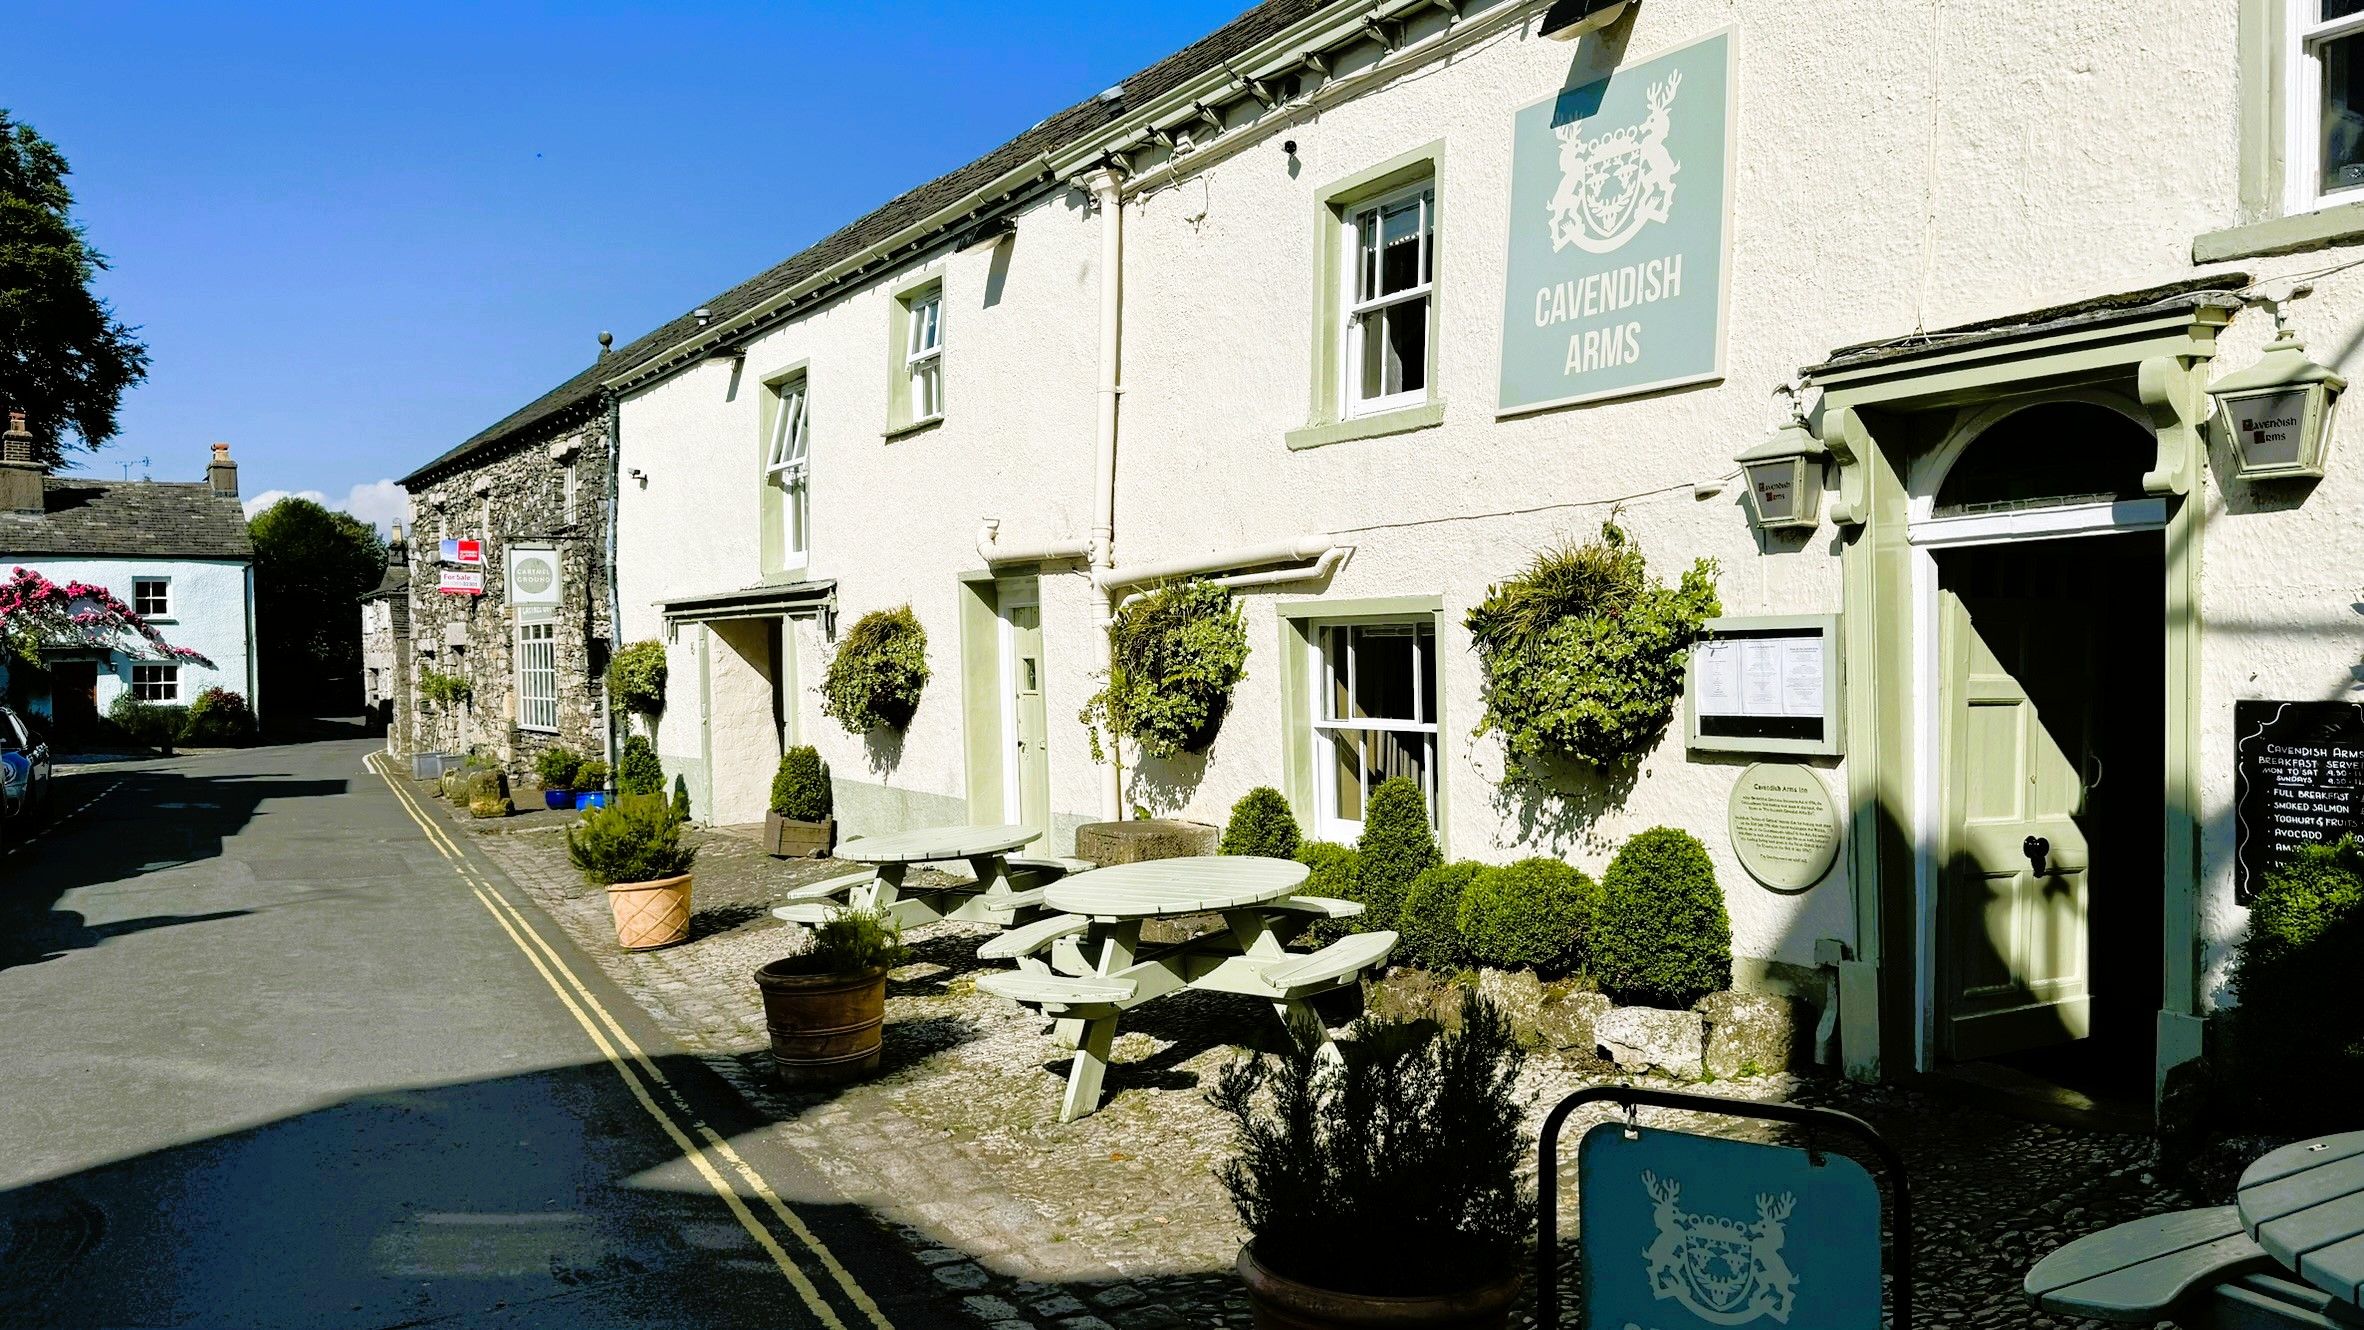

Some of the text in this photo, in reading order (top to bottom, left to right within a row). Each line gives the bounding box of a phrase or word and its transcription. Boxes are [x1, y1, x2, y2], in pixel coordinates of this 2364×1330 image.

[1535, 253, 1683, 328] CAVENDISH
[1564, 321, 1641, 376] ARMS
[517, 568, 551, 576] CARTMEL
[2267, 744, 2328, 757] CAVENDISH
[2259, 756, 2318, 768] BREAKFAST
[2287, 768, 2299, 776] TO
[2276, 775, 2312, 784] SUNDAYS
[1754, 783, 1781, 791] Cavendish
[2274, 788, 2294, 798] FULL
[2298, 790, 2349, 801] BREAKFAST
[2274, 802, 2310, 811] SMOKED
[2312, 804, 2350, 813] SALMON
[2274, 814, 2358, 828] YOGHURT & FRUITS
[2274, 828, 2322, 840] AVOCADO
